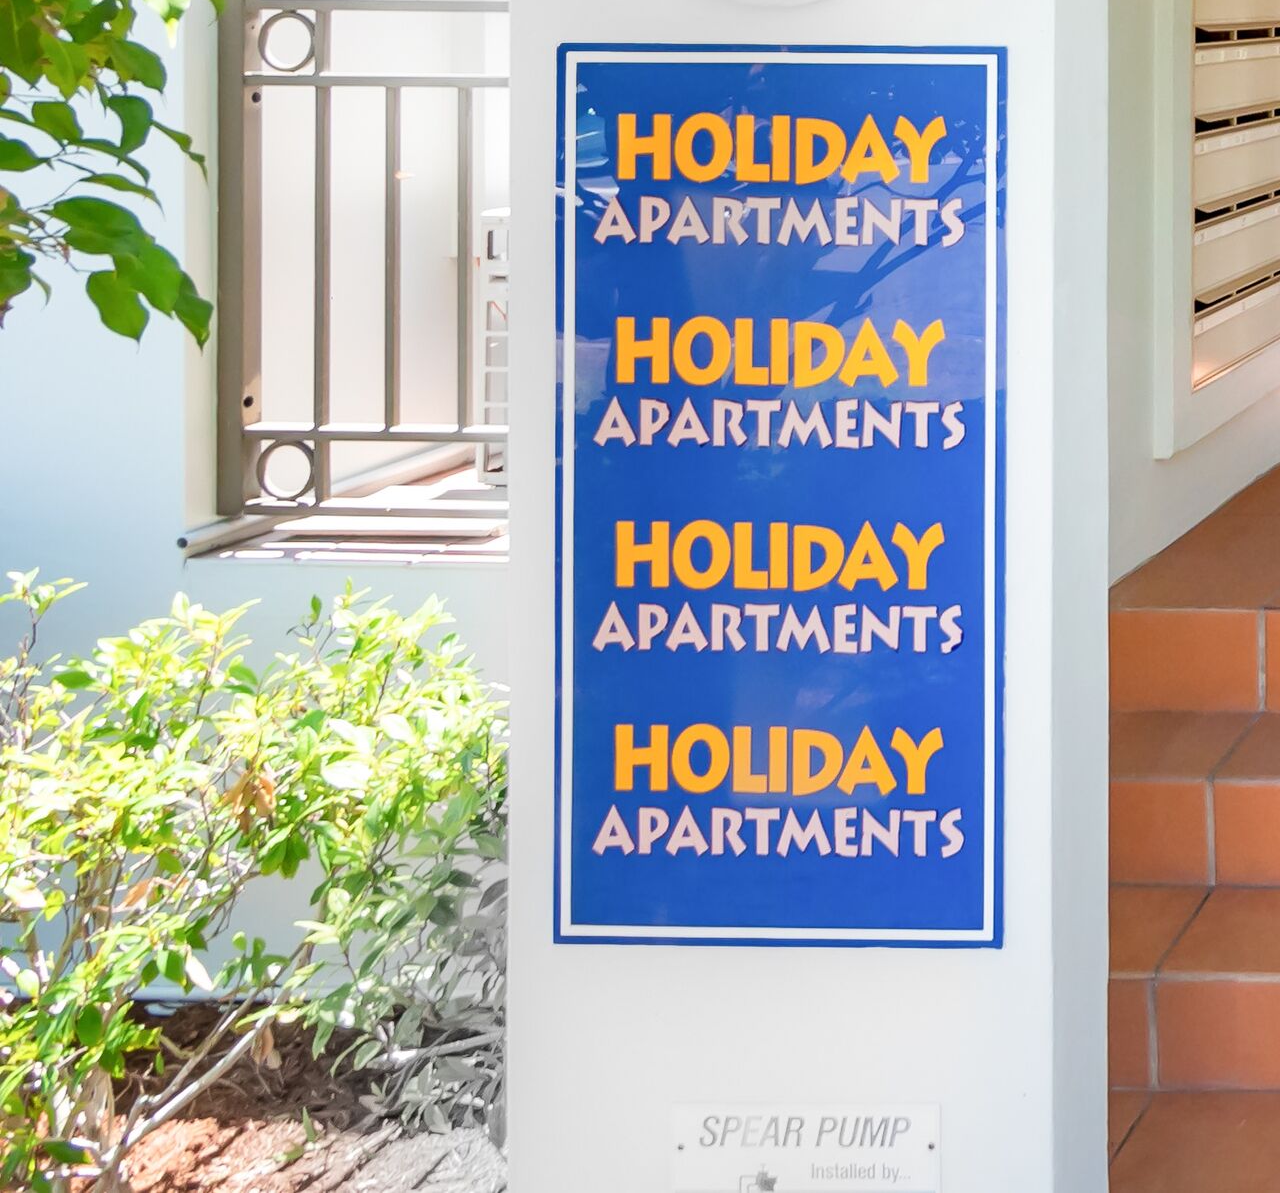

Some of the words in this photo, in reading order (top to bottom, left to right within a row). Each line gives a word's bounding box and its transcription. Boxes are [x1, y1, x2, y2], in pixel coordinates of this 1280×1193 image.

[617, 112, 947, 185] HOLIDAY
[594, 196, 966, 247] APARTMENTS
[616, 316, 945, 388] HOLIDAY
[593, 396, 966, 449] APARTMENTS
[615, 520, 945, 592] HOLIDAY
[592, 601, 964, 654] APARTMENTS
[614, 723, 944, 796] HOLIDAY
[592, 804, 965, 858] APARTMENTS
[699, 1115, 805, 1148] SPEAR
[815, 1115, 912, 1148] PUMP
[810, 1162, 876, 1180] Installed
